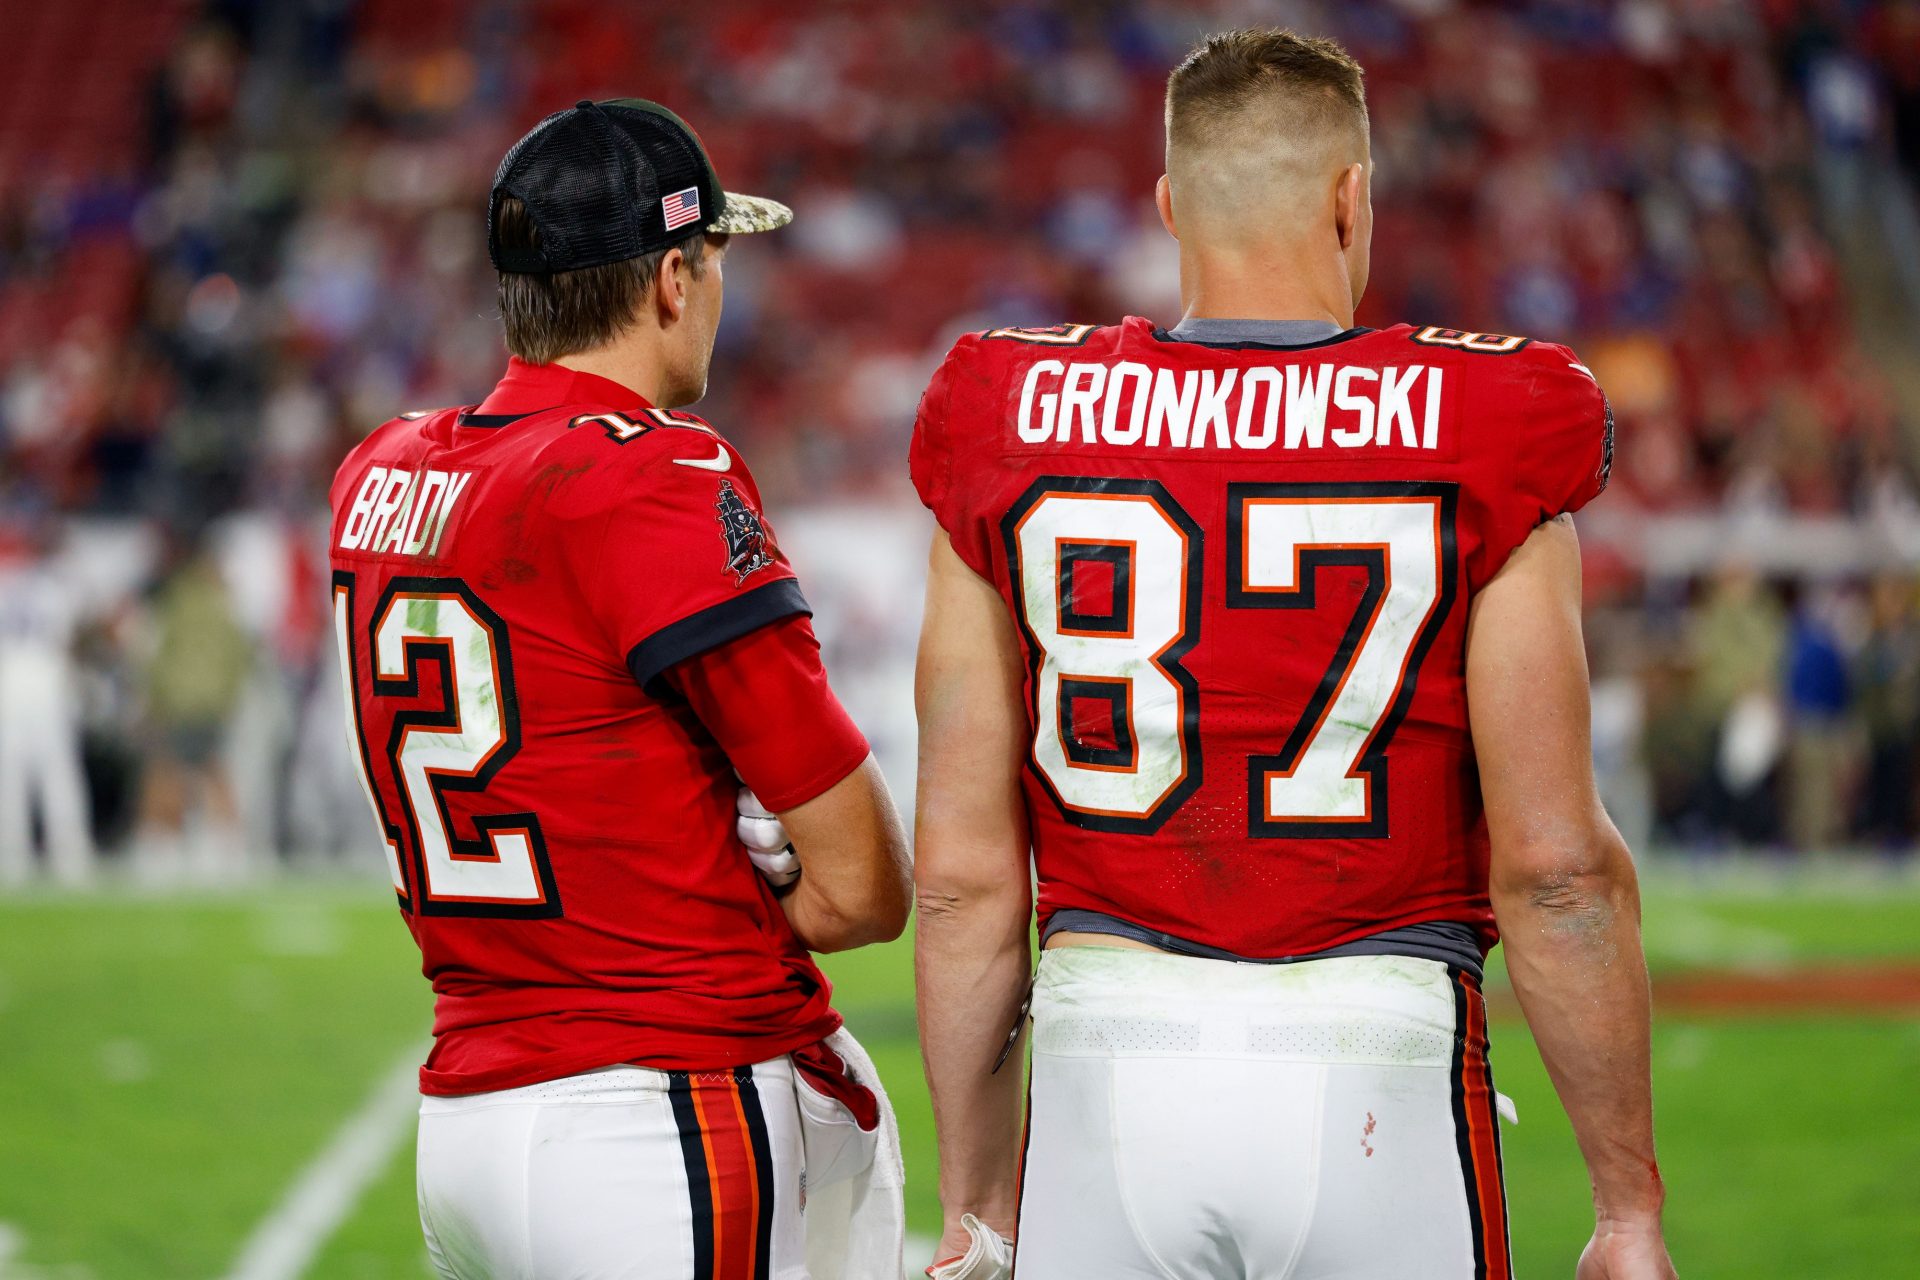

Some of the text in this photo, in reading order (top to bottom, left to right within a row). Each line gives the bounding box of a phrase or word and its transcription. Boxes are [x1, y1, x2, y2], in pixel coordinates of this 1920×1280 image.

[340, 466, 472, 557] BRADY
[1016, 359, 1444, 450] GRONKOWSKI
[332, 570, 565, 920] 12
[1001, 475, 1460, 839] 87
